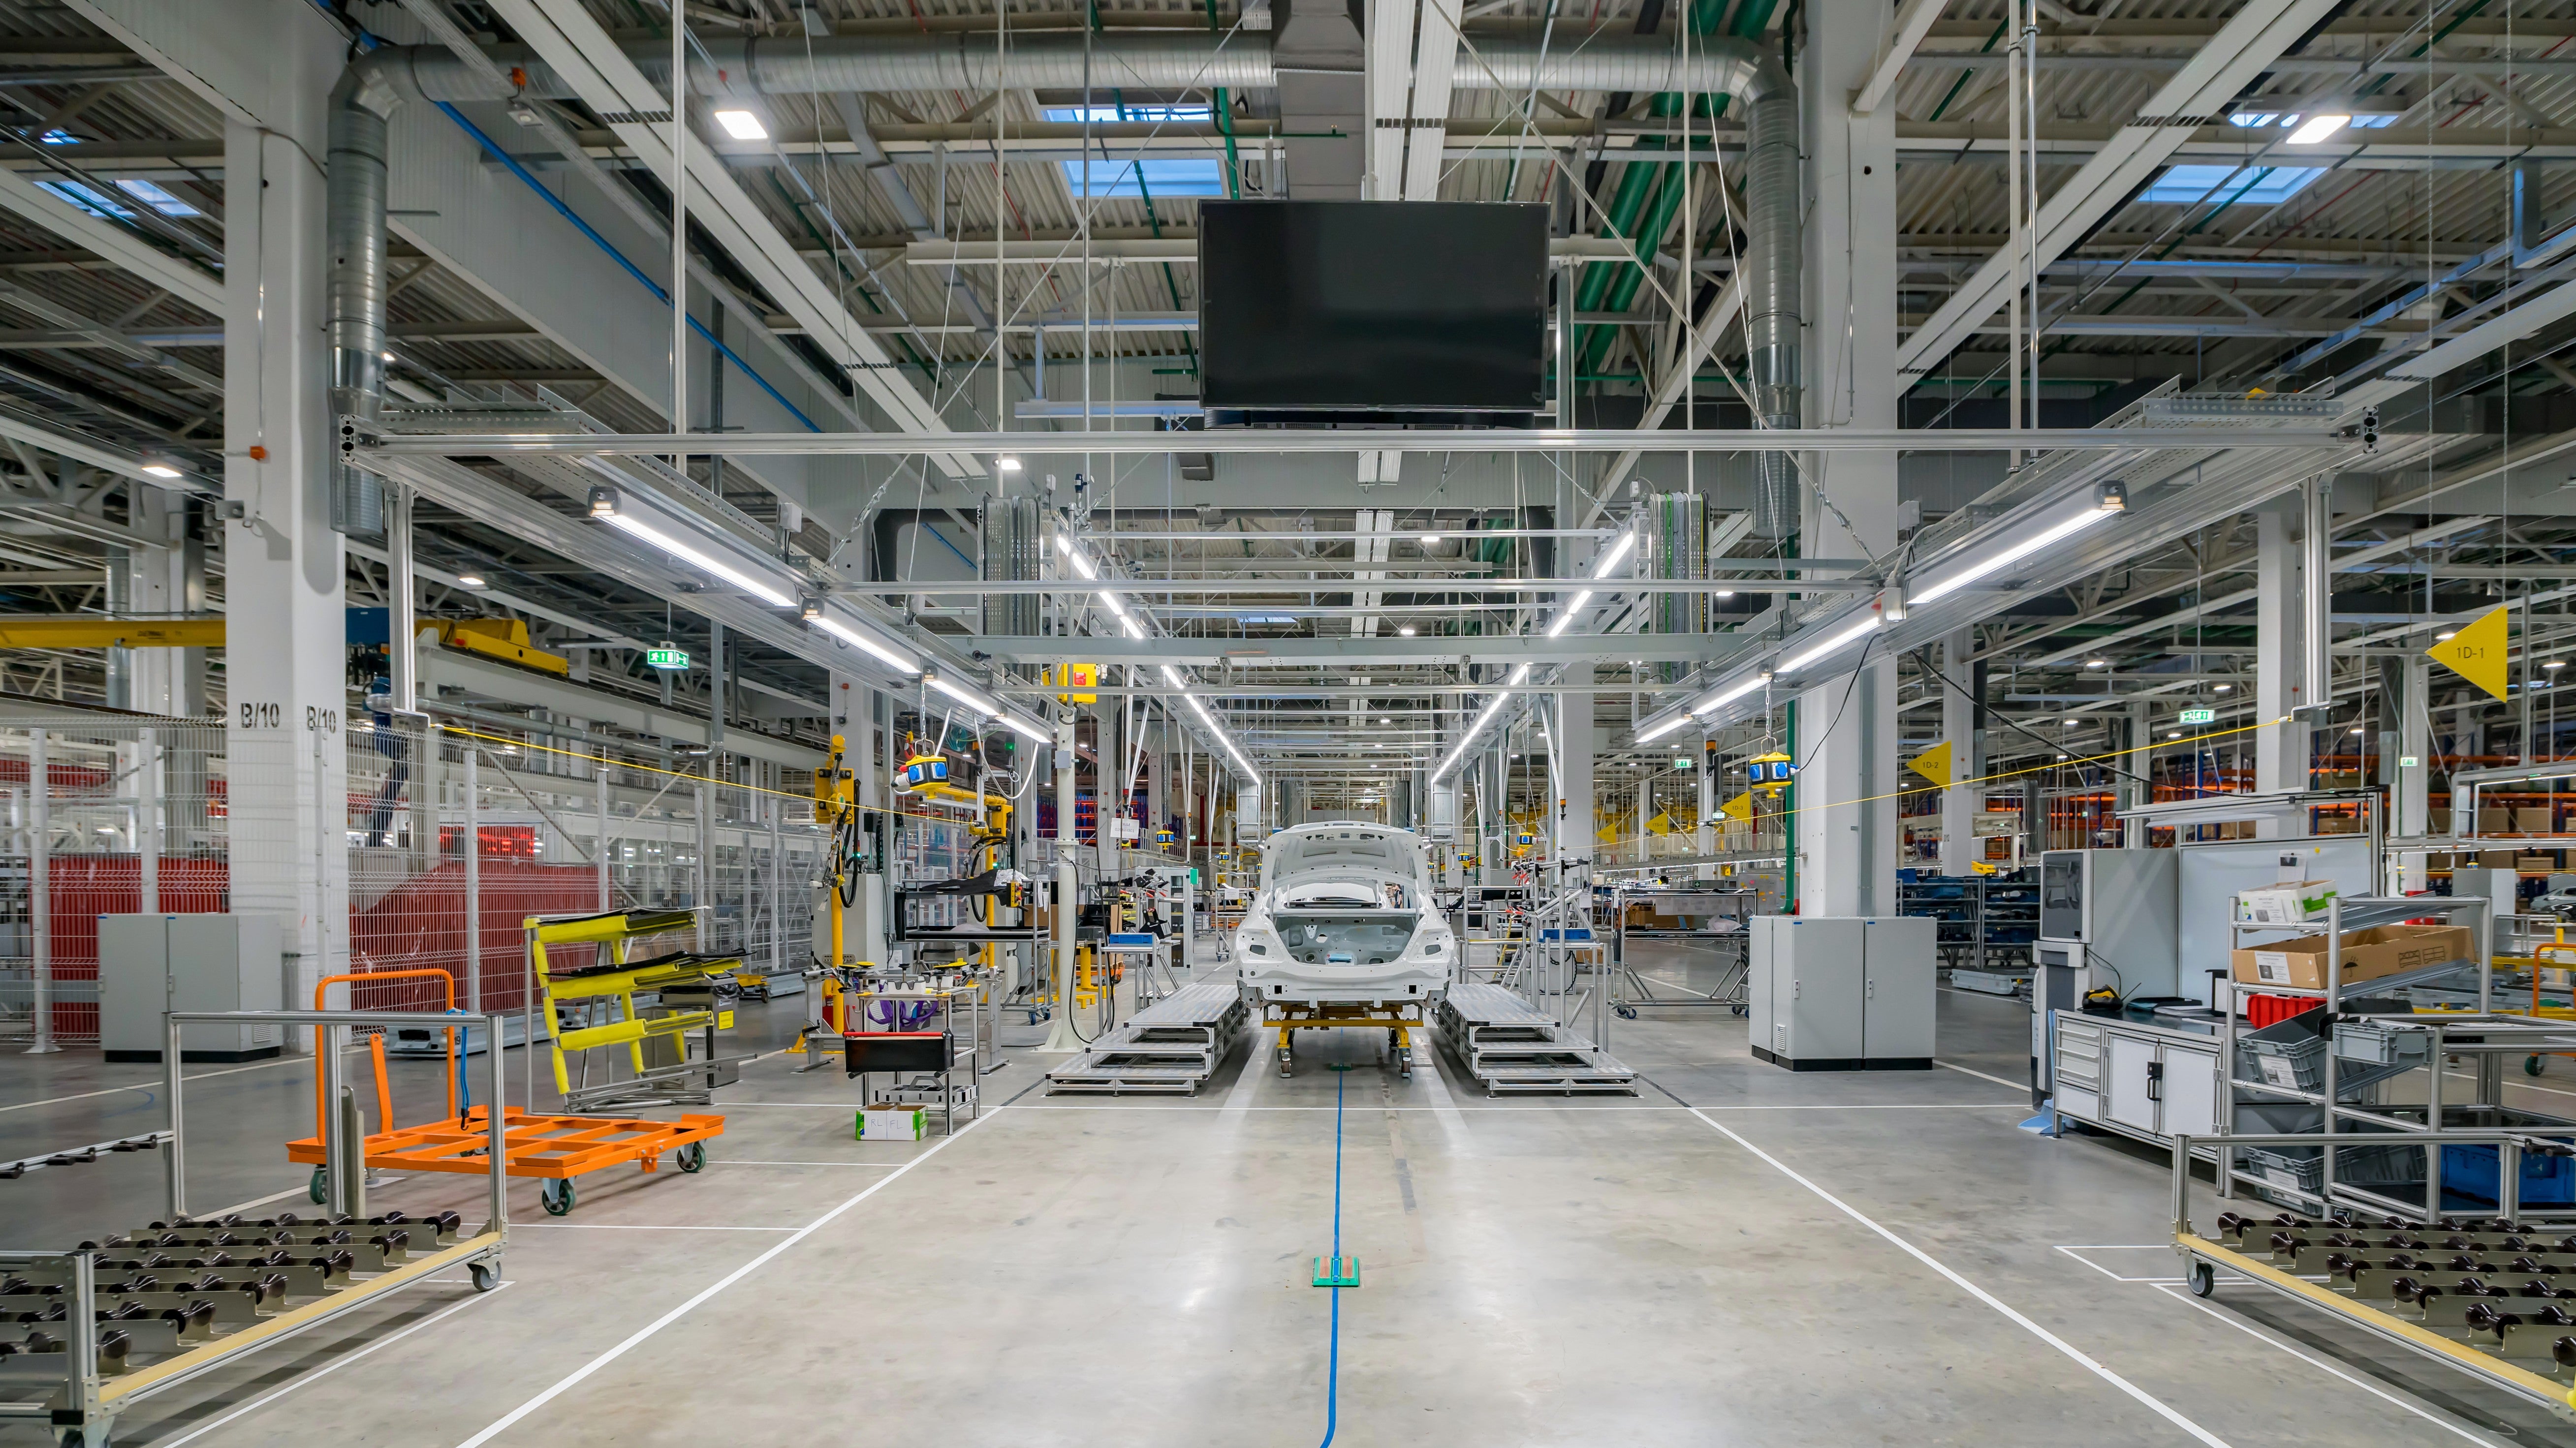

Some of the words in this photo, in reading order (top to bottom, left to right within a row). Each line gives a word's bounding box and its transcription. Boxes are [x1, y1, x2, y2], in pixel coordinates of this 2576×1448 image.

[2457, 647, 2483, 659] 1D-1
[241, 703, 279, 728] B/10
[307, 705, 336, 734] B/10
[871, 1118, 882, 1128] RL
[890, 1119, 903, 1130] FL
